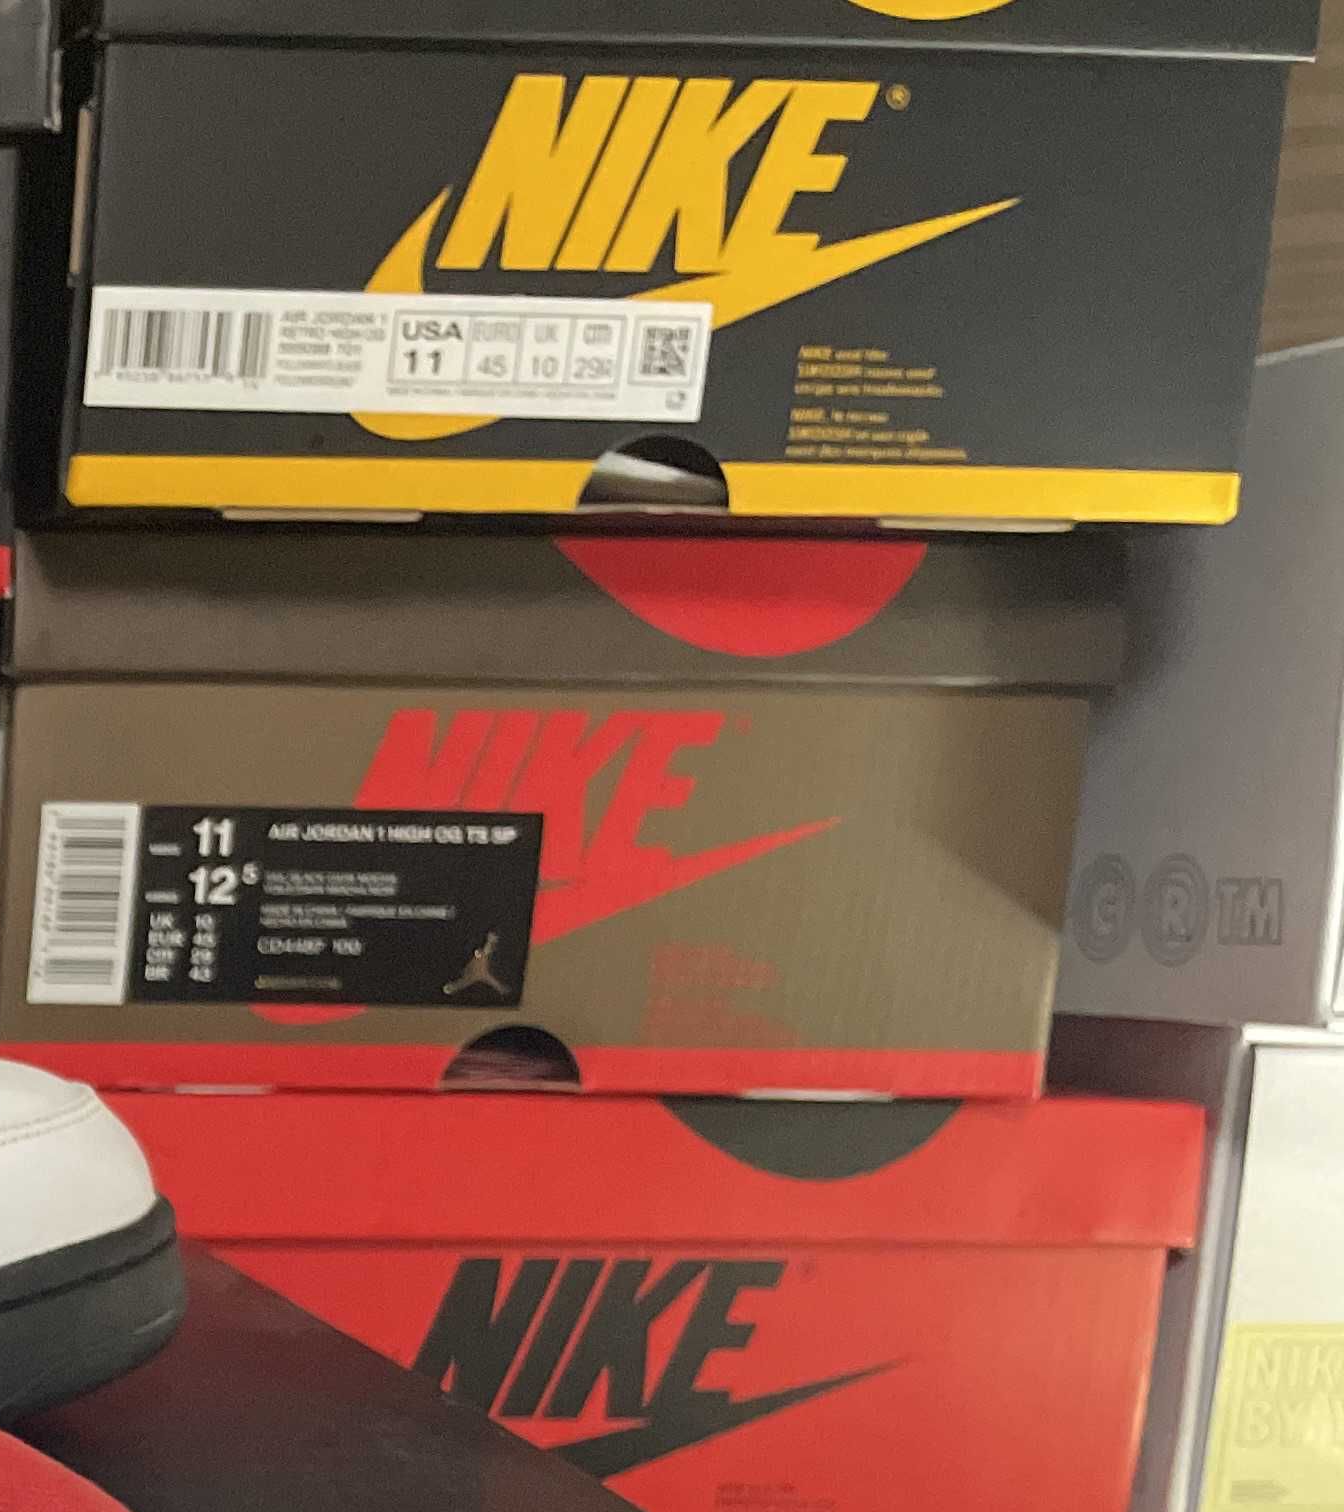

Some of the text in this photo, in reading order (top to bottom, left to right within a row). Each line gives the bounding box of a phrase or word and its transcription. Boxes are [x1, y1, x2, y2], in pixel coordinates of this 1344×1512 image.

[436, 74, 880, 274] NIKE
[402, 321, 463, 342] USA
[403, 349, 442, 377] 11
[193, 816, 234, 858] 11
[268, 822, 300, 841] AIR
[301, 823, 375, 843] JORDAN
[413, 1258, 789, 1421] NIKE
